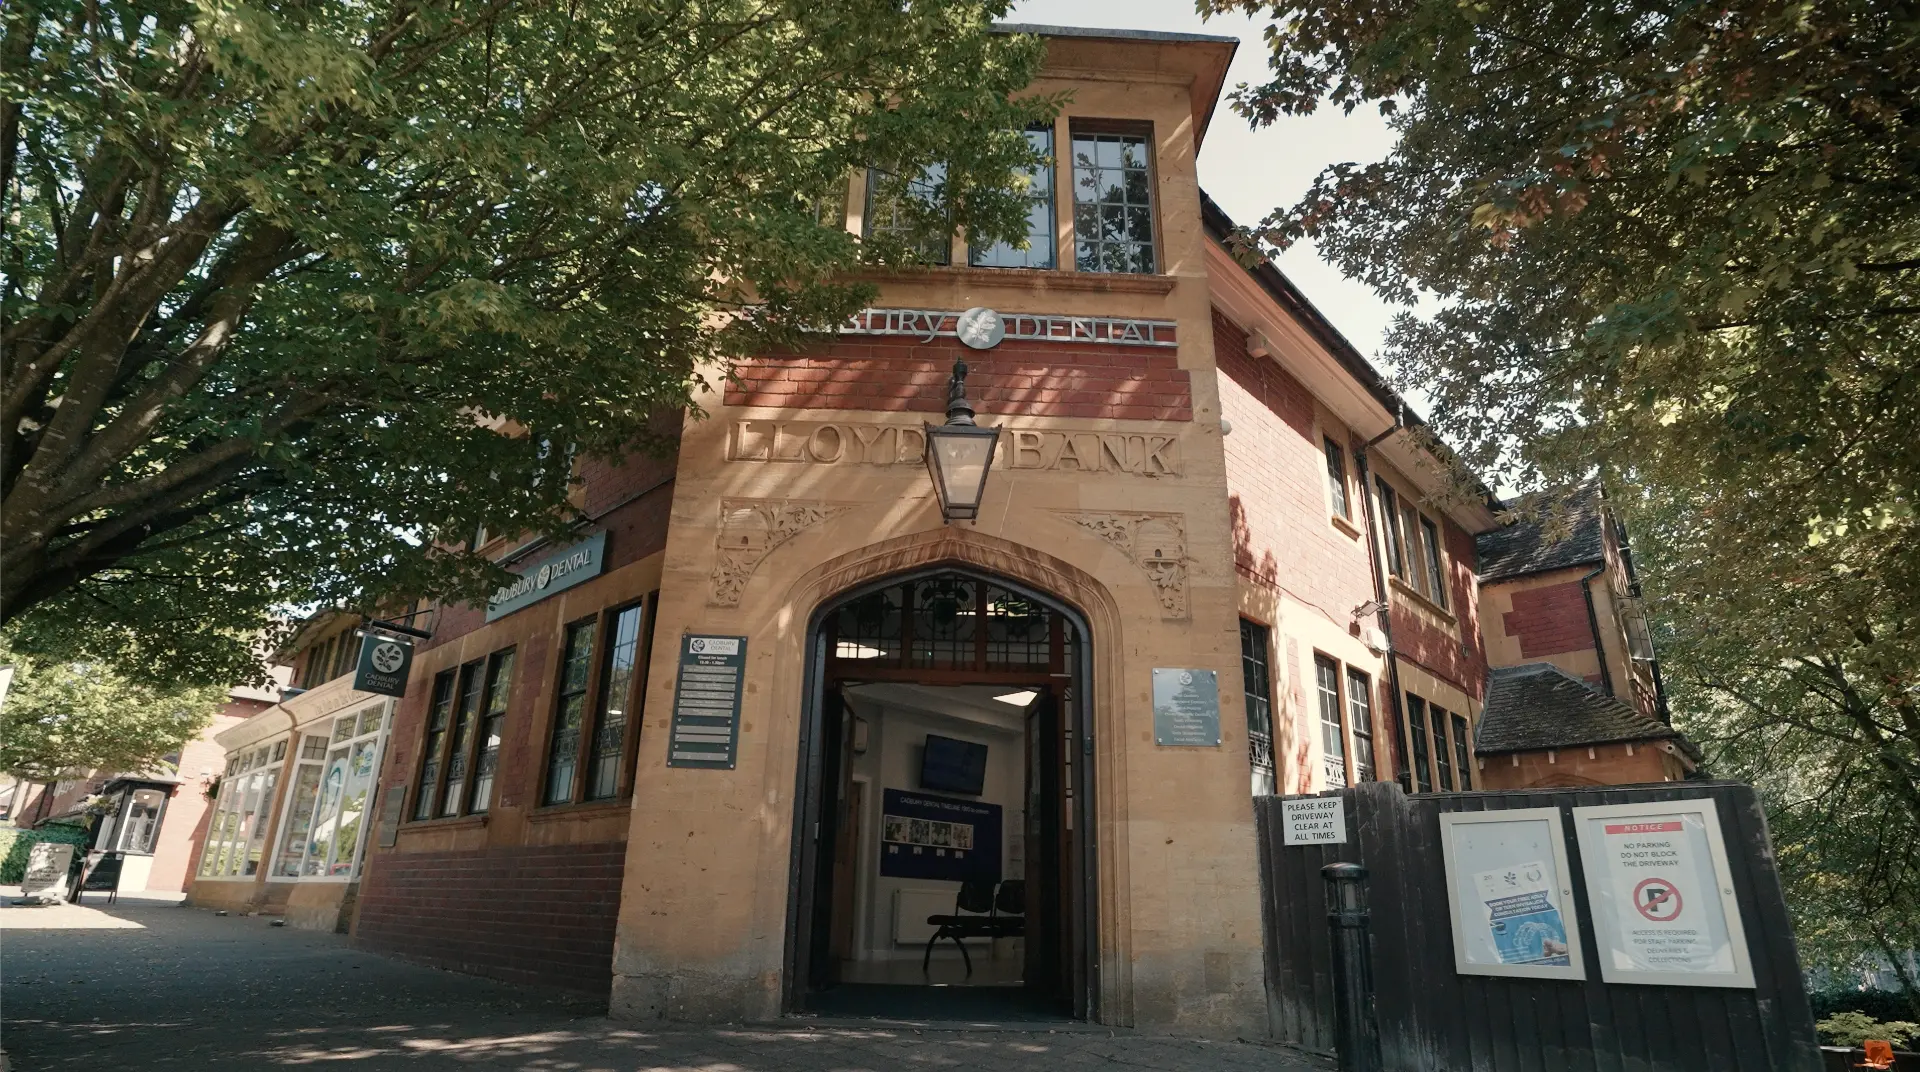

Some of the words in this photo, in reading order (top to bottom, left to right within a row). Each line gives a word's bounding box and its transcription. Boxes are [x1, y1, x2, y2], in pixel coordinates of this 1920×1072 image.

[1015, 313, 1160, 346] DENTAL
[734, 420, 927, 465] LLOYD
[1010, 430, 1180, 476] BANK
[551, 548, 590, 580] DENTAL
[364, 672, 400, 685] CADBURY
[367, 679, 395, 690] DENTAL
[1287, 803, 1315, 812] PLEASE
[1317, 801, 1337, 810] KEEP
[1291, 811, 1334, 821] DRIVEWAY
[1294, 822, 1319, 831] CLEAR
[1322, 821, 1333, 829] AT
[1623, 823, 1664, 833] NOTICE
[1294, 833, 1309, 841] ALL
[1311, 831, 1336, 840] TIMES
[1636, 841, 1671, 849] PARKING
[1650, 850, 1678, 858] BLOCK
[1638, 859, 1679, 868] DRIVEWAY
